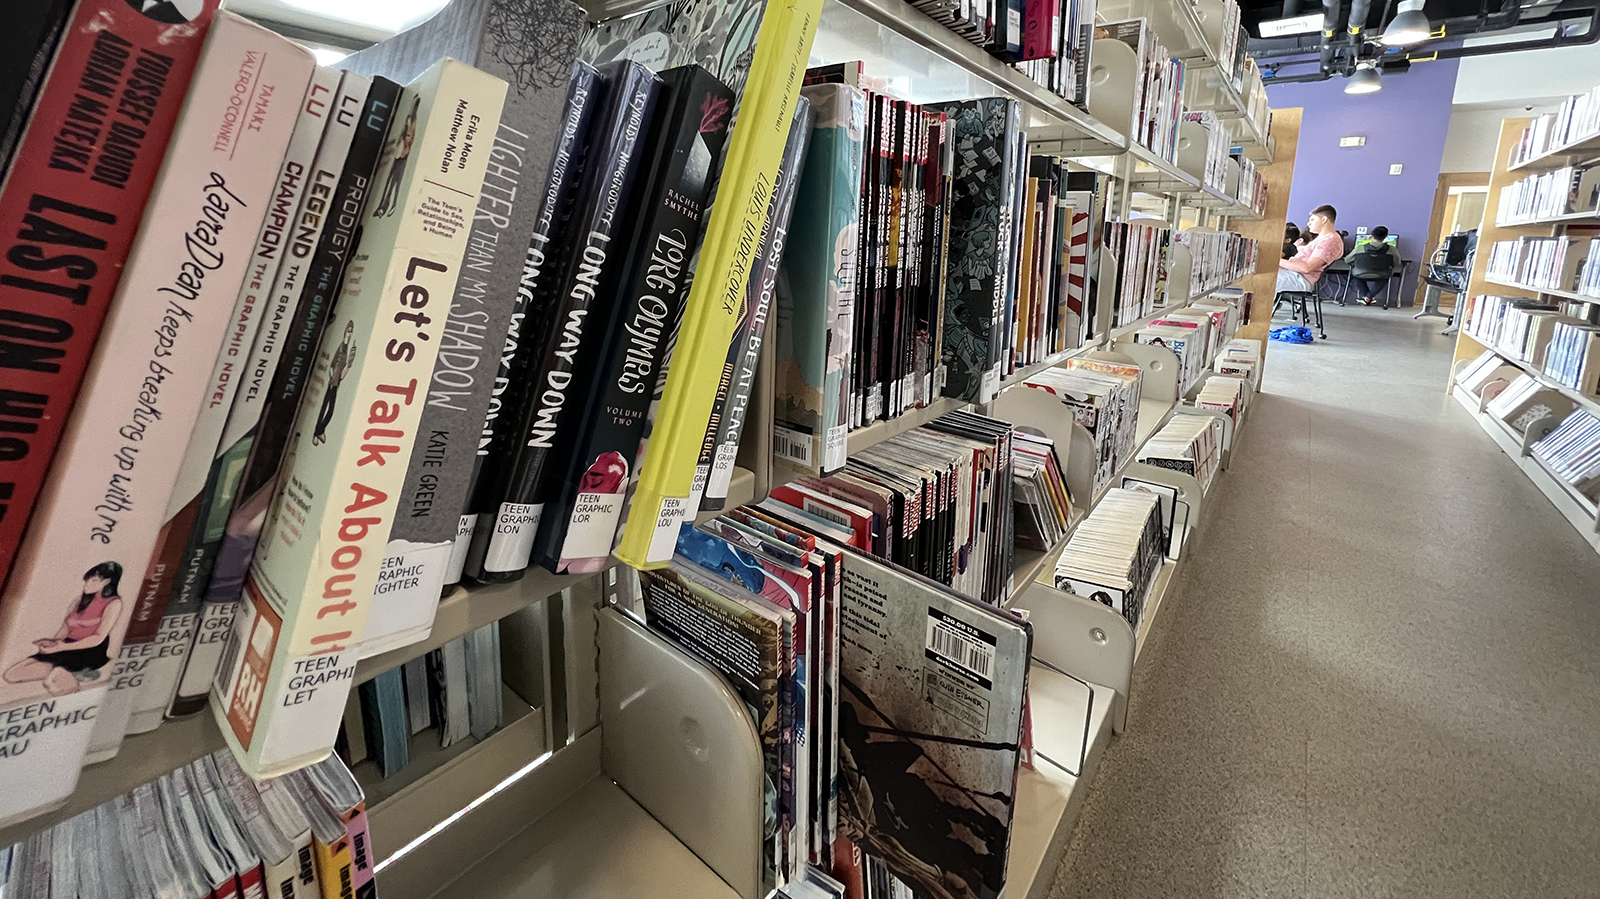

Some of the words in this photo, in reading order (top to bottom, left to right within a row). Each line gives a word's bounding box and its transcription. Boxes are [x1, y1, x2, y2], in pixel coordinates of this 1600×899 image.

[78, 29, 134, 99] ADRIAN
[117, 48, 175, 126] YOUSSEF
[213, 50, 260, 152] VALERO-O'CONNELL
[306, 84, 329, 118] LU
[248, 84, 274, 133] TAMAKI
[337, 95, 359, 127] LU
[367, 100, 388, 132] LU
[448, 99, 469, 143] Matthew
[467, 114, 481, 139] Erika
[566, 86, 588, 140] REYNOLDS
[625, 91, 648, 142] REYNOLDS
[48, 93, 109, 174] MATEJKA
[90, 122, 146, 190] DAOUDI
[440, 143, 457, 174] Nolan
[458, 139, 474, 170] Moen
[257, 161, 303, 260] CHAMPION
[293, 169, 335, 259] LEGEND
[328, 173, 367, 262] PRODIGY
[421, 202, 441, 213] Guide
[428, 196, 440, 206] The
[663, 198, 699, 221] SMYTHE
[667, 189, 701, 212] RACHEL
[997, 205, 1006, 251] STUCK
[0, 193, 117, 306] LAST
[466, 229, 500, 273] THAN
[570, 230, 611, 302] LONG
[722, 220, 758, 316] UNDERCOVER
[767, 226, 787, 273] LOST
[250, 264, 267, 290] THE
[284, 265, 300, 291] THE
[318, 265, 332, 290] THE
[458, 275, 489, 305] MY
[385, 256, 448, 363] Let's
[991, 275, 1001, 326] MIDDLE
[154, 300, 194, 357] keeps
[228, 295, 257, 357] GRAPHIC
[263, 295, 290, 354] GRAPHIC
[299, 295, 323, 352] GRAPHIC
[554, 309, 588, 365] WAY
[428, 304, 490, 411] SHADOW
[744, 335, 762, 364] BE
[209, 362, 234, 409] NOVEL
[246, 359, 268, 402] NOVEL
[283, 356, 303, 400] NOVEL
[716, 362, 734, 402] MORECI
[738, 367, 753, 388] AT
[119, 360, 173, 441] breaking
[527, 370, 573, 448] DOWN
[605, 406, 643, 420] VOLUME
[356, 378, 418, 467] Talk
[612, 418, 632, 427] TWO
[700, 413, 722, 462] MILLEDGE
[114, 446, 138, 470] up
[423, 430, 449, 468] KATIE
[715, 462, 728, 470] LOS
[95, 474, 134, 511] with
[411, 473, 438, 519] GREEN
[503, 504, 532, 514] TEEN
[575, 503, 614, 514] GRAPHIC
[578, 494, 601, 503] TEEN
[664, 499, 681, 508] TEEN
[90, 513, 117, 544] me
[497, 525, 521, 535] LON
[573, 514, 591, 523] LOR
[658, 518, 673, 527] LOU
[316, 482, 388, 620] About
[381, 556, 404, 569] EEN
[179, 549, 203, 604] PUTNAM
[373, 578, 419, 595] IGHTER
[378, 564, 425, 582] RAPHIC
[137, 563, 166, 622] PUTNAM
[211, 602, 240, 615] TEE
[160, 615, 196, 630] TEE
[942, 615, 967, 631] $20.00
[118, 643, 154, 659] TEE
[294, 655, 340, 674] TEEN
[288, 666, 355, 691] GRAPHI
[283, 688, 318, 707] LET
[0, 739, 30, 758] AU
